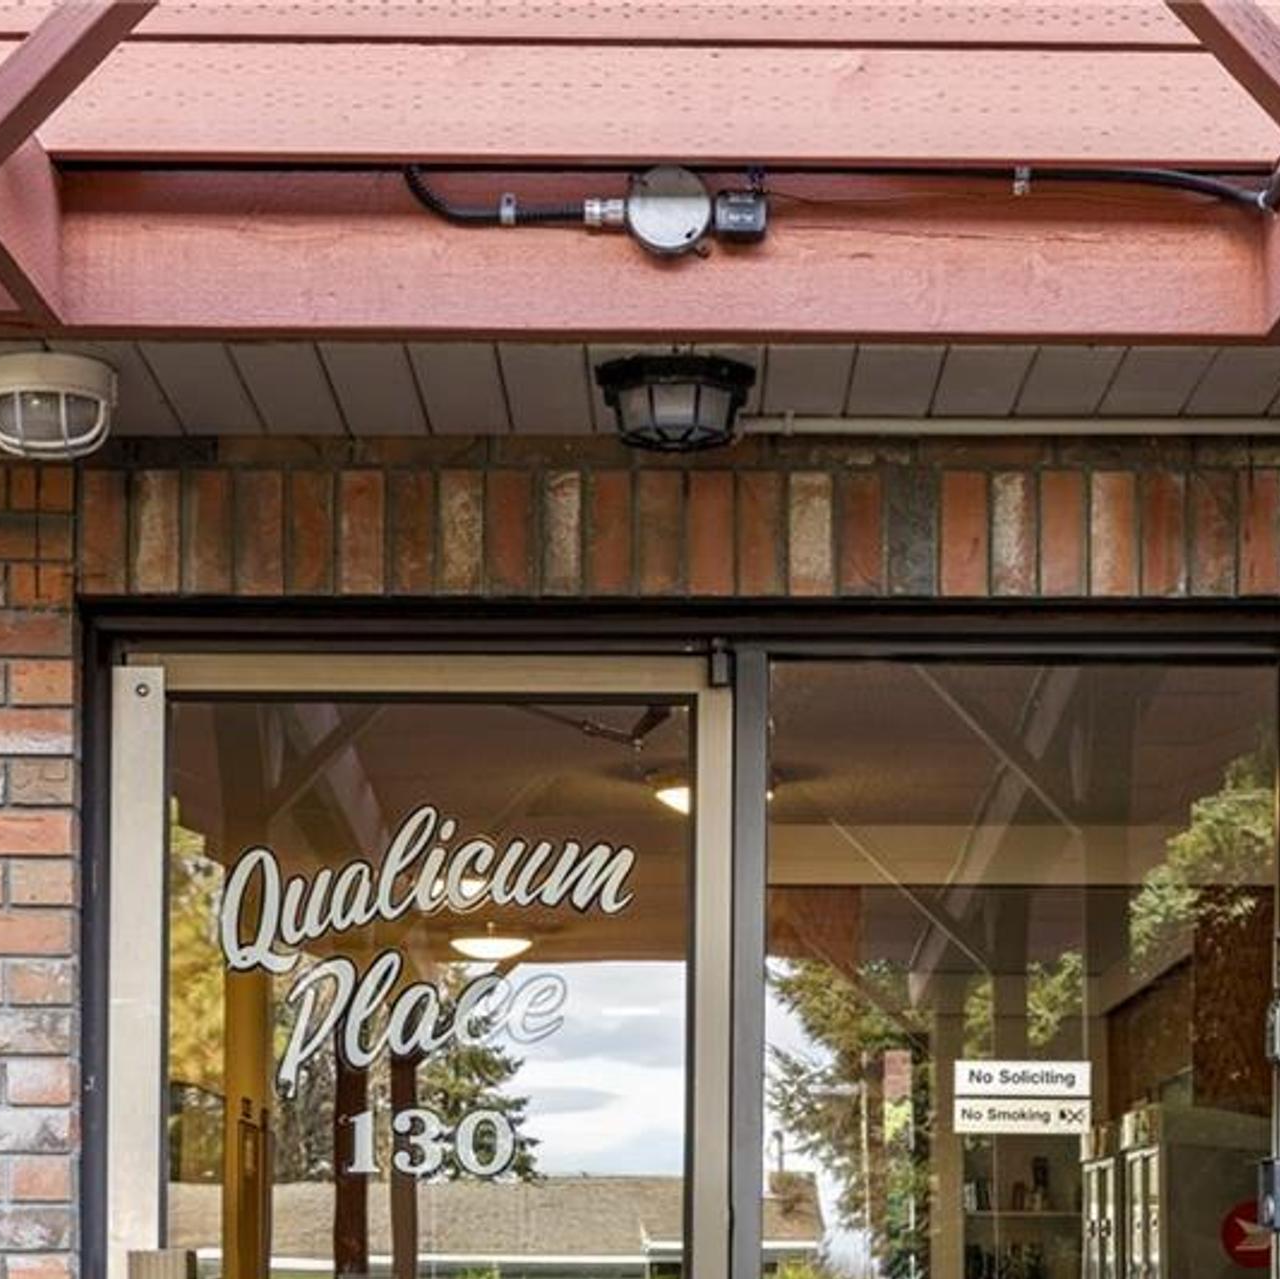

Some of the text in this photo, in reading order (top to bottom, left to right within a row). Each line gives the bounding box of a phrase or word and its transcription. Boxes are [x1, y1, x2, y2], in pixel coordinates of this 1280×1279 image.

[221, 804, 636, 974] Qualicum
[275, 950, 568, 1099] Place
[968, 1069, 1076, 1088] No Soliciting
[344, 1106, 519, 1179] 130
[960, 1108, 1051, 1123] No Smoking
